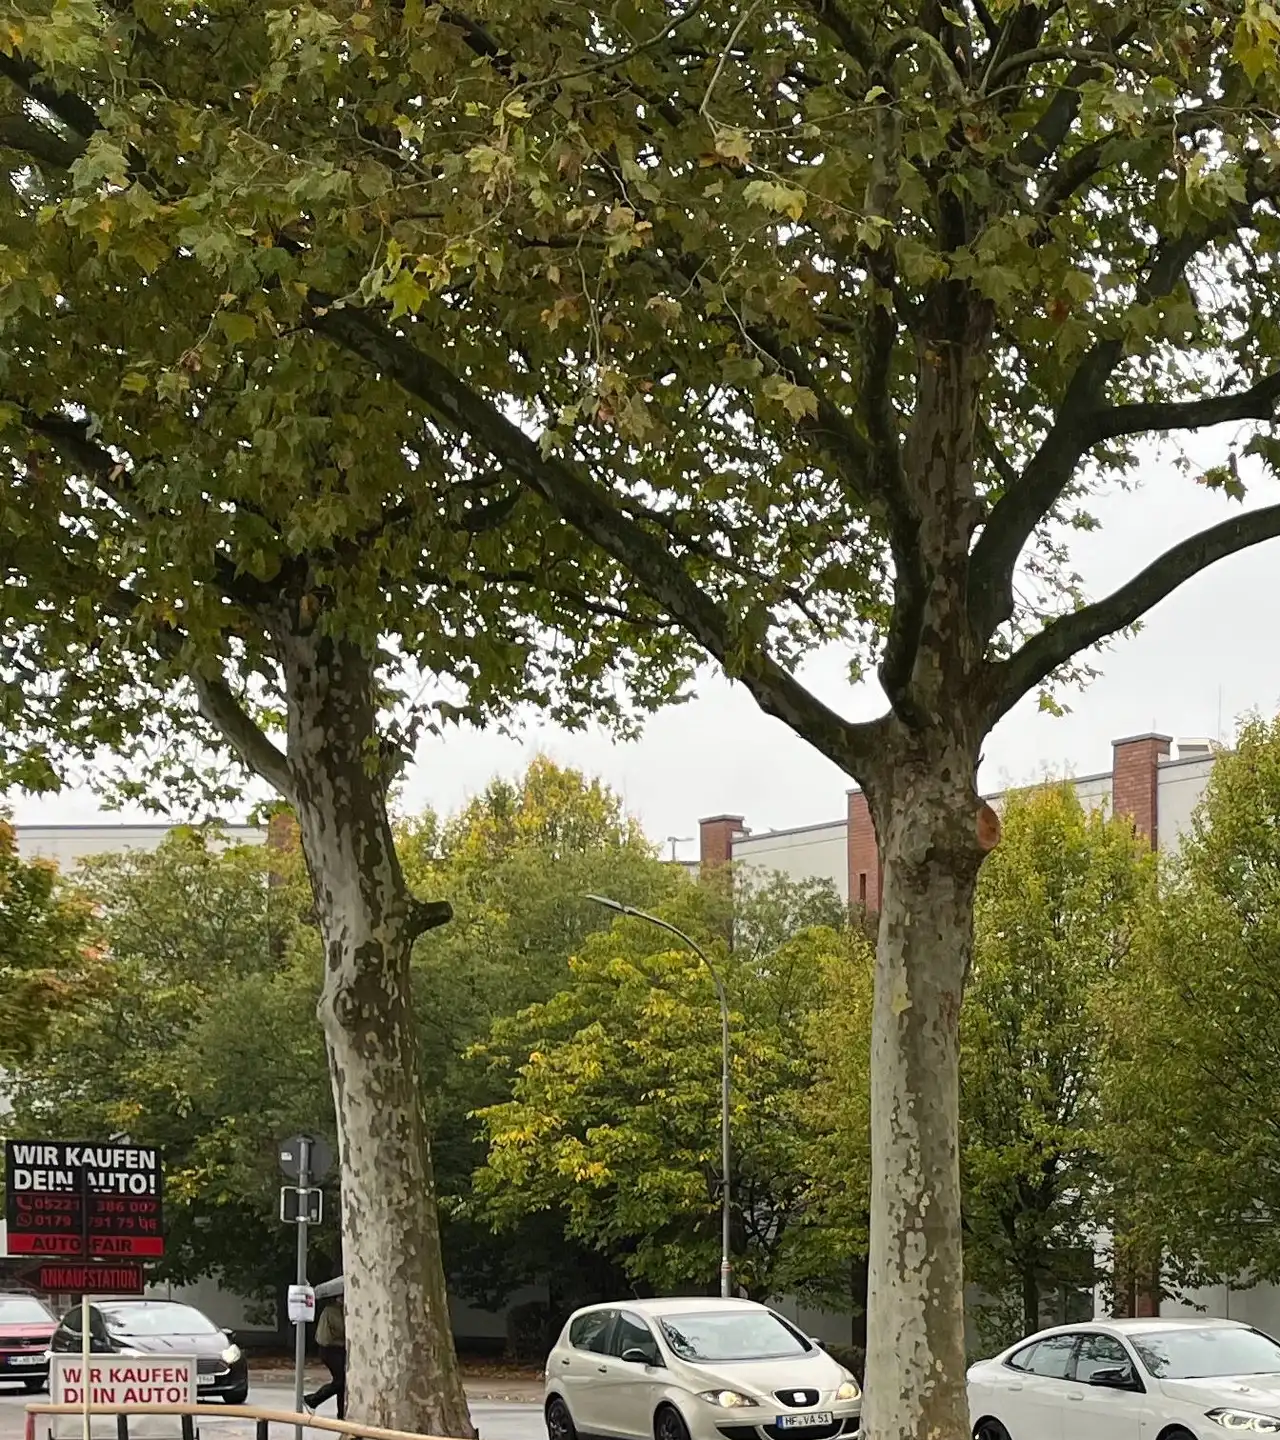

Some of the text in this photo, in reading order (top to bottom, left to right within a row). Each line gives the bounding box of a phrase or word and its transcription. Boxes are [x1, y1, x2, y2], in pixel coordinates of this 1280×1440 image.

[13, 1145, 155, 1169] WIR KAUFEN
[14, 1169, 155, 1194] DEIN AUTO!
[41, 1268, 138, 1289] ANKAUFSTATION
[63, 1368, 102, 1383] WR
[109, 1368, 188, 1383] KAUFEN
[64, 1388, 188, 1403] DIN AUTO!
